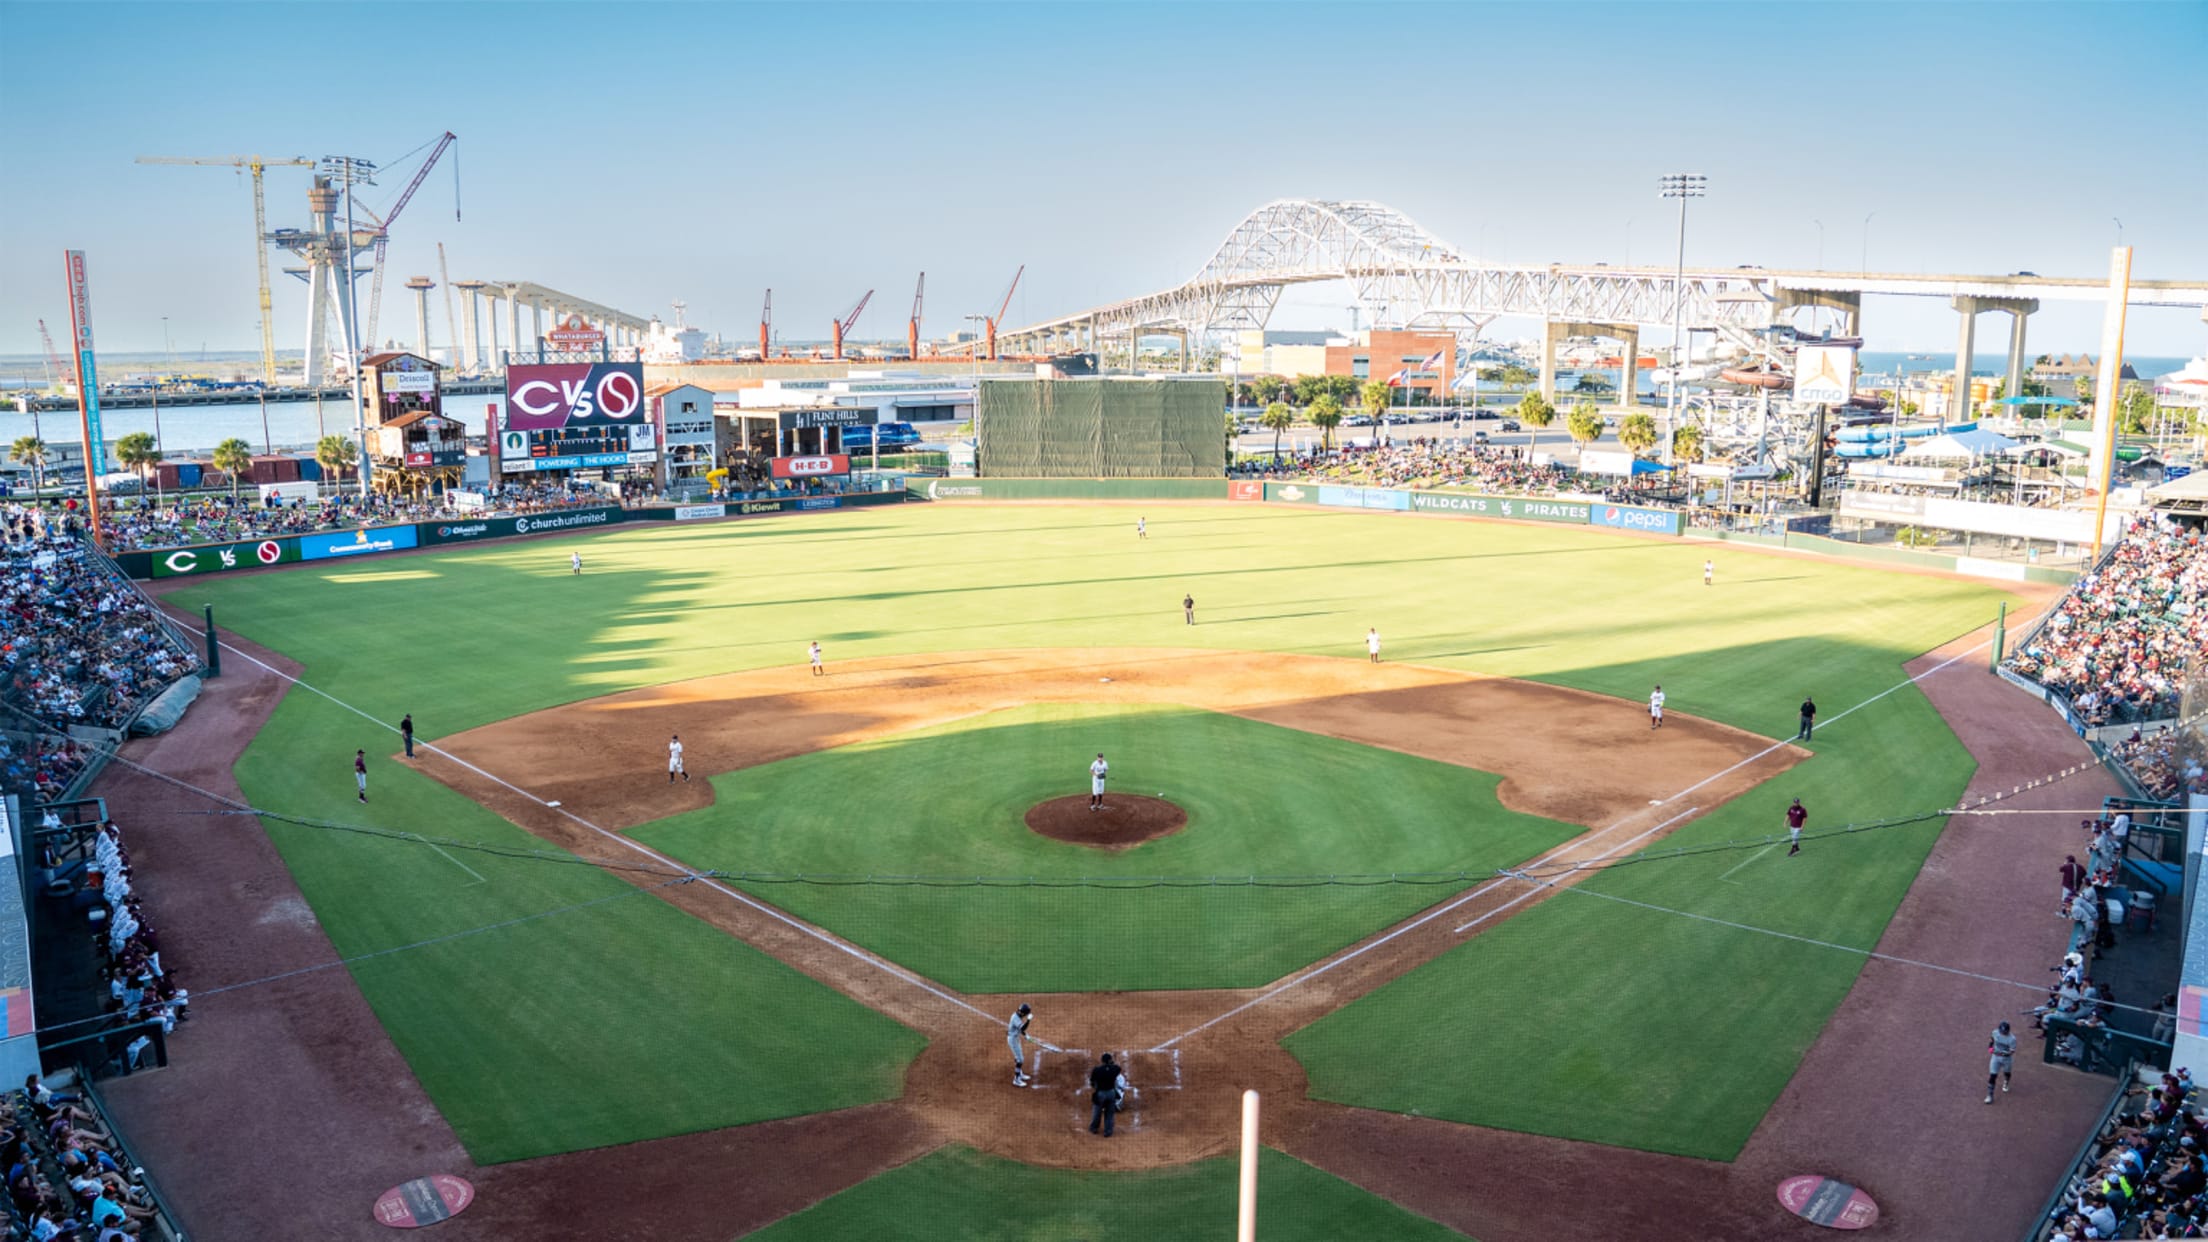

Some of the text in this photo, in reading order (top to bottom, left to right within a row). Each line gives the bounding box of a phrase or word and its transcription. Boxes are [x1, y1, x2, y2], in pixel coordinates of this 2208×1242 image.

[399, 374, 430, 382] Driscoll
[1800, 388, 1843, 401] CITGO
[813, 411, 835, 421] FLINT
[836, 410, 859, 420] HILLS
[539, 454, 626, 467] POWERING THE HOOKS
[751, 502, 780, 512] Kiewit
[1413, 496, 1488, 511] WILDCATS
[1524, 503, 1589, 518] PIRATES
[1624, 511, 1667, 529] pepsi
